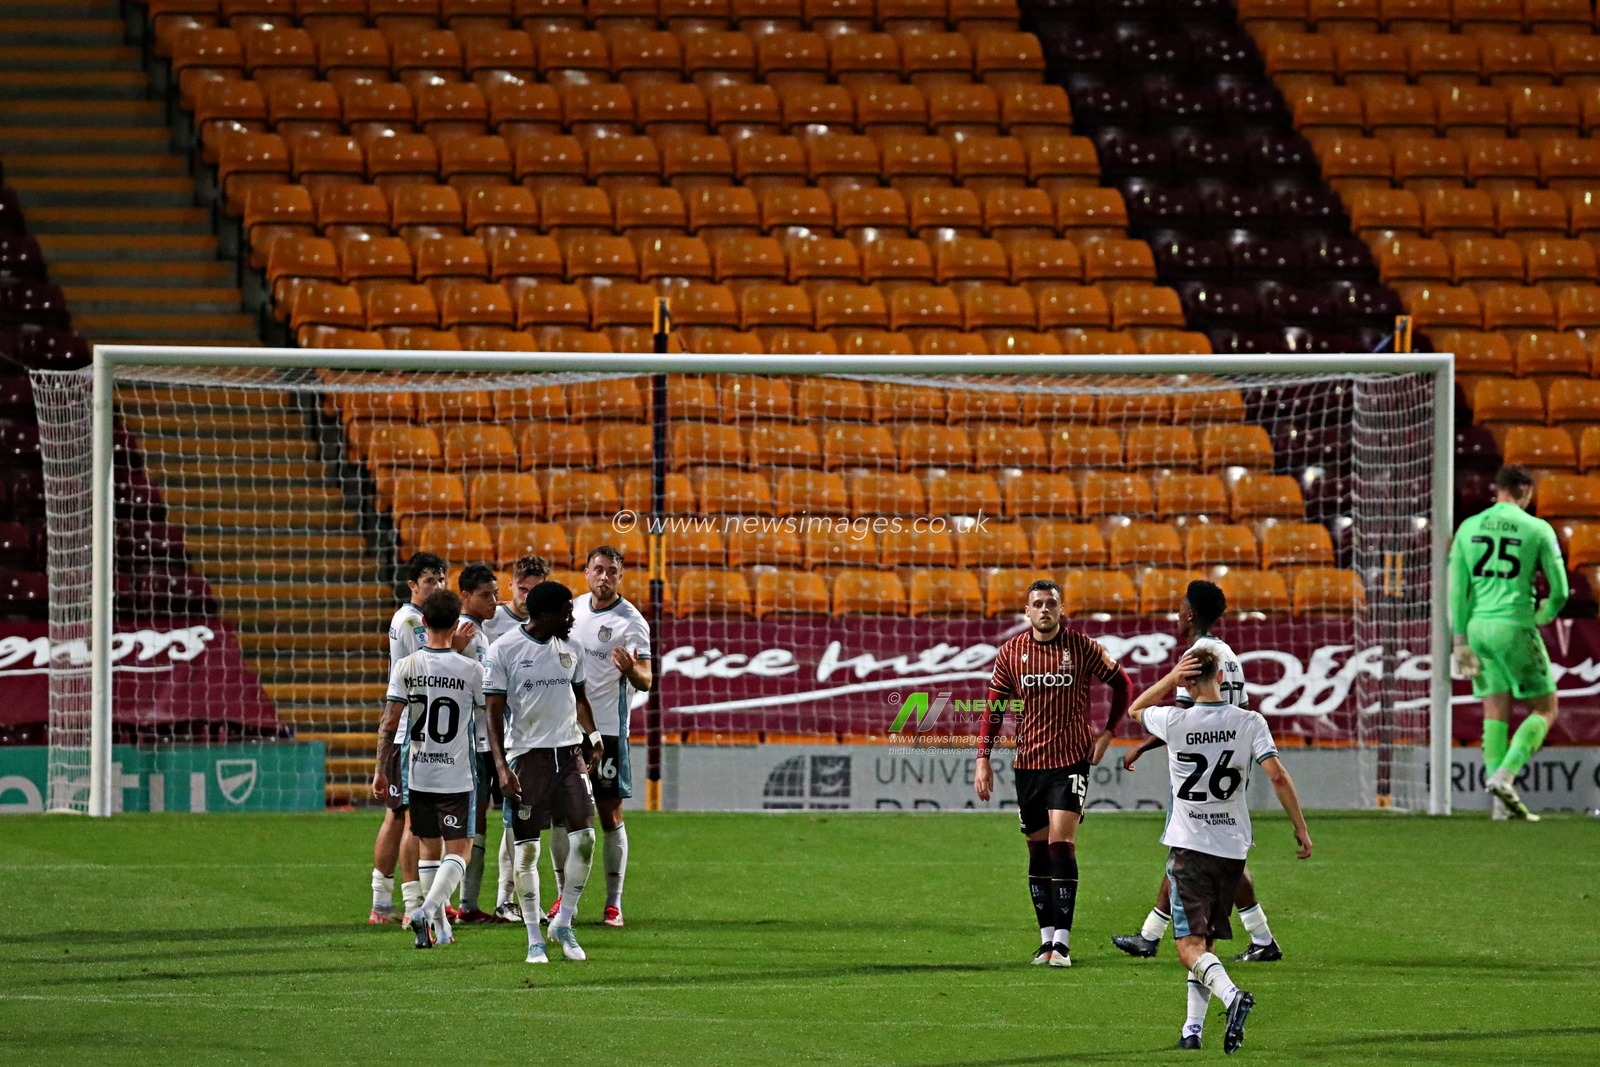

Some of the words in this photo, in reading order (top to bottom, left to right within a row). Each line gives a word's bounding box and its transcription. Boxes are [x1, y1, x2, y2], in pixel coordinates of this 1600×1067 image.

[1471, 535, 1522, 579] 25
[407, 694, 460, 744] 20
[1186, 730, 1236, 745] GRAHAM
[1068, 774, 1087, 798] 15
[1177, 750, 1241, 801] 26
